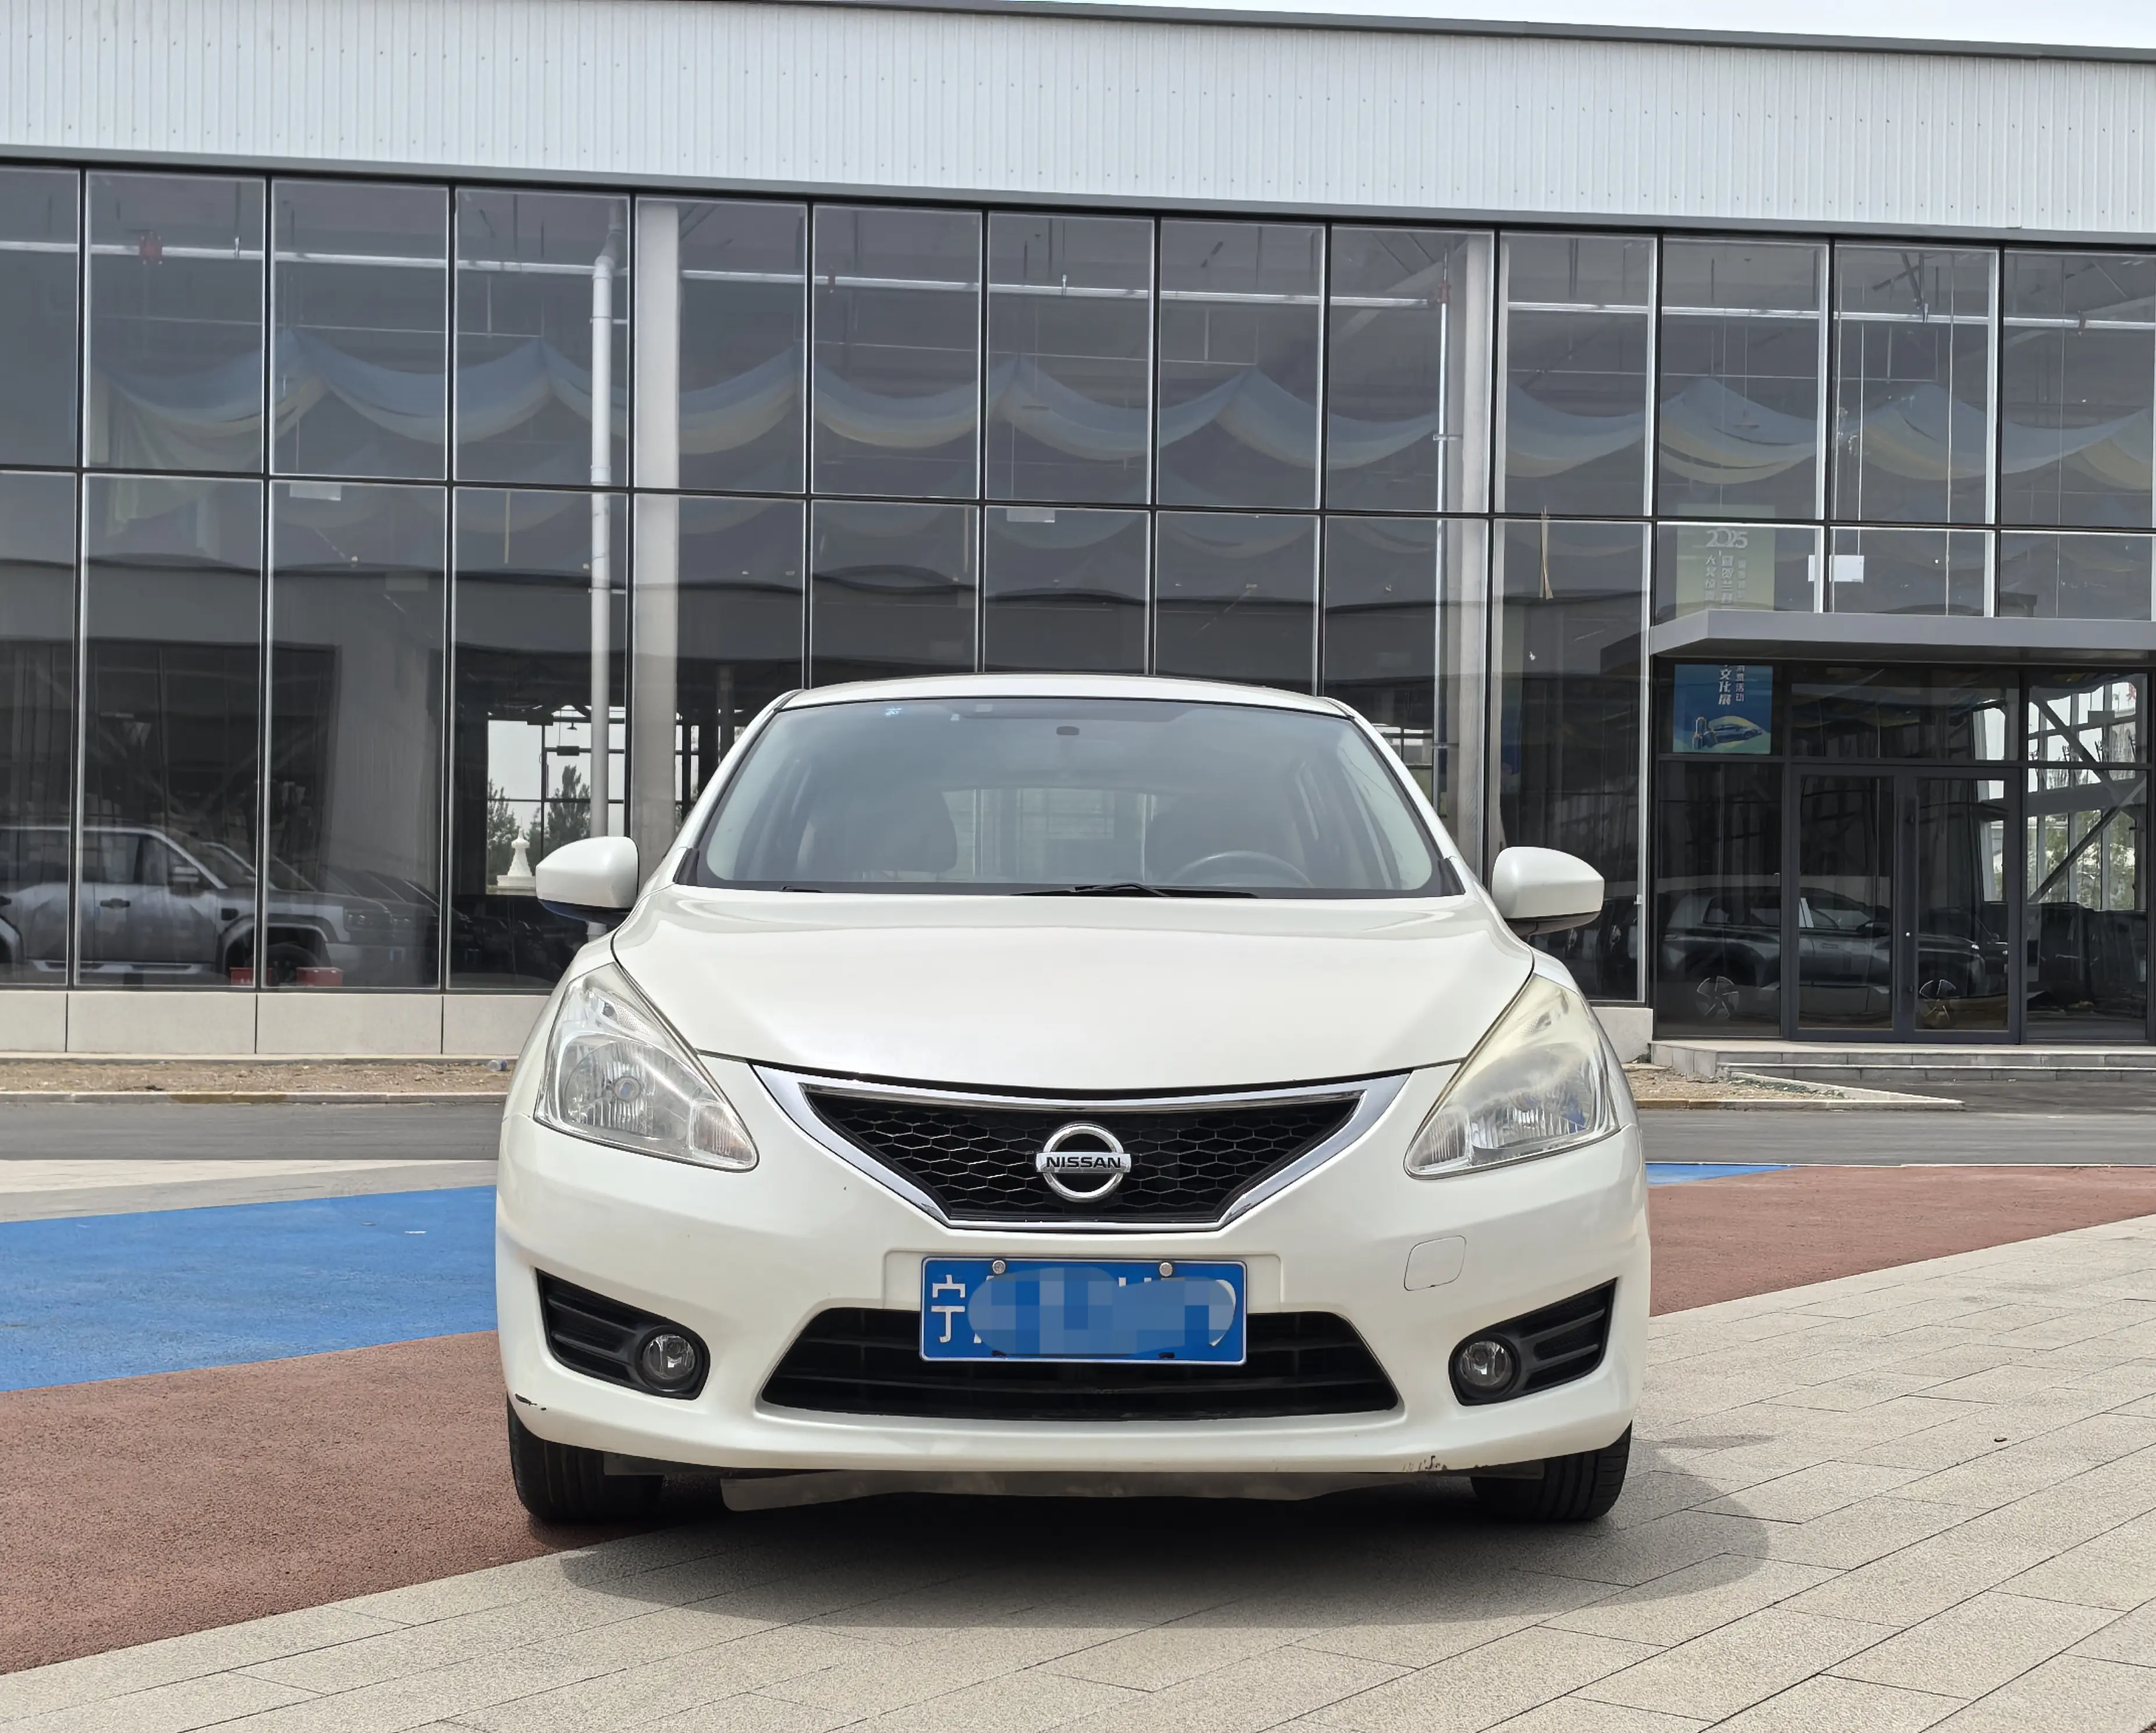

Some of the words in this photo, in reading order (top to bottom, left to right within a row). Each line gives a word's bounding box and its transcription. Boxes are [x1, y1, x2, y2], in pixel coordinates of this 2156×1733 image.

[1705, 528, 1748, 548] 2025
[1718, 665, 1732, 705] 文化展
[1046, 1156, 1121, 1169] NISSAN
